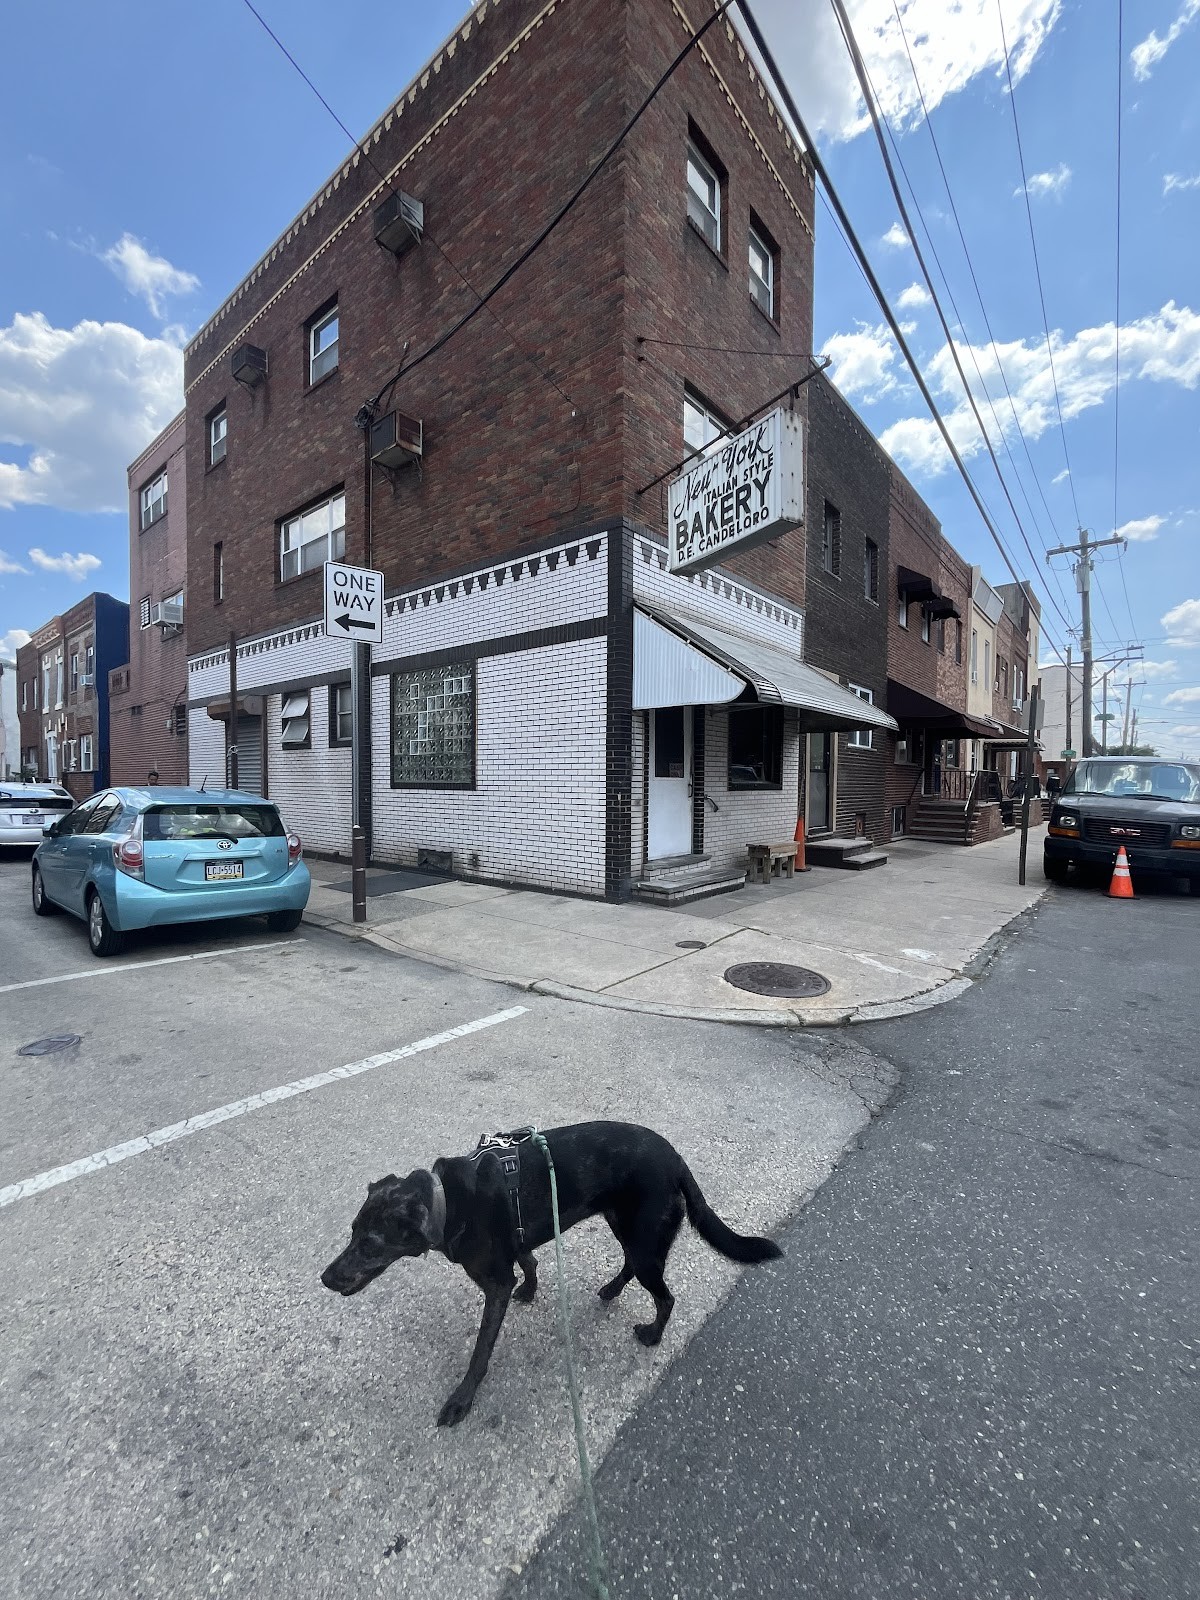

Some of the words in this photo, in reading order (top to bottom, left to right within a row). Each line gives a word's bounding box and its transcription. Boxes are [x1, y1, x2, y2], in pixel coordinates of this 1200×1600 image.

[673, 461, 719, 520] New
[722, 425, 774, 478] York
[703, 474, 738, 507] ITALIAN
[743, 452, 774, 482] STYLE
[676, 468, 772, 550] BAKERY
[678, 548, 695, 563] D.E.
[699, 506, 770, 552] CANDELORO
[333, 570, 376, 593] ONE
[333, 590, 376, 612] WAY
